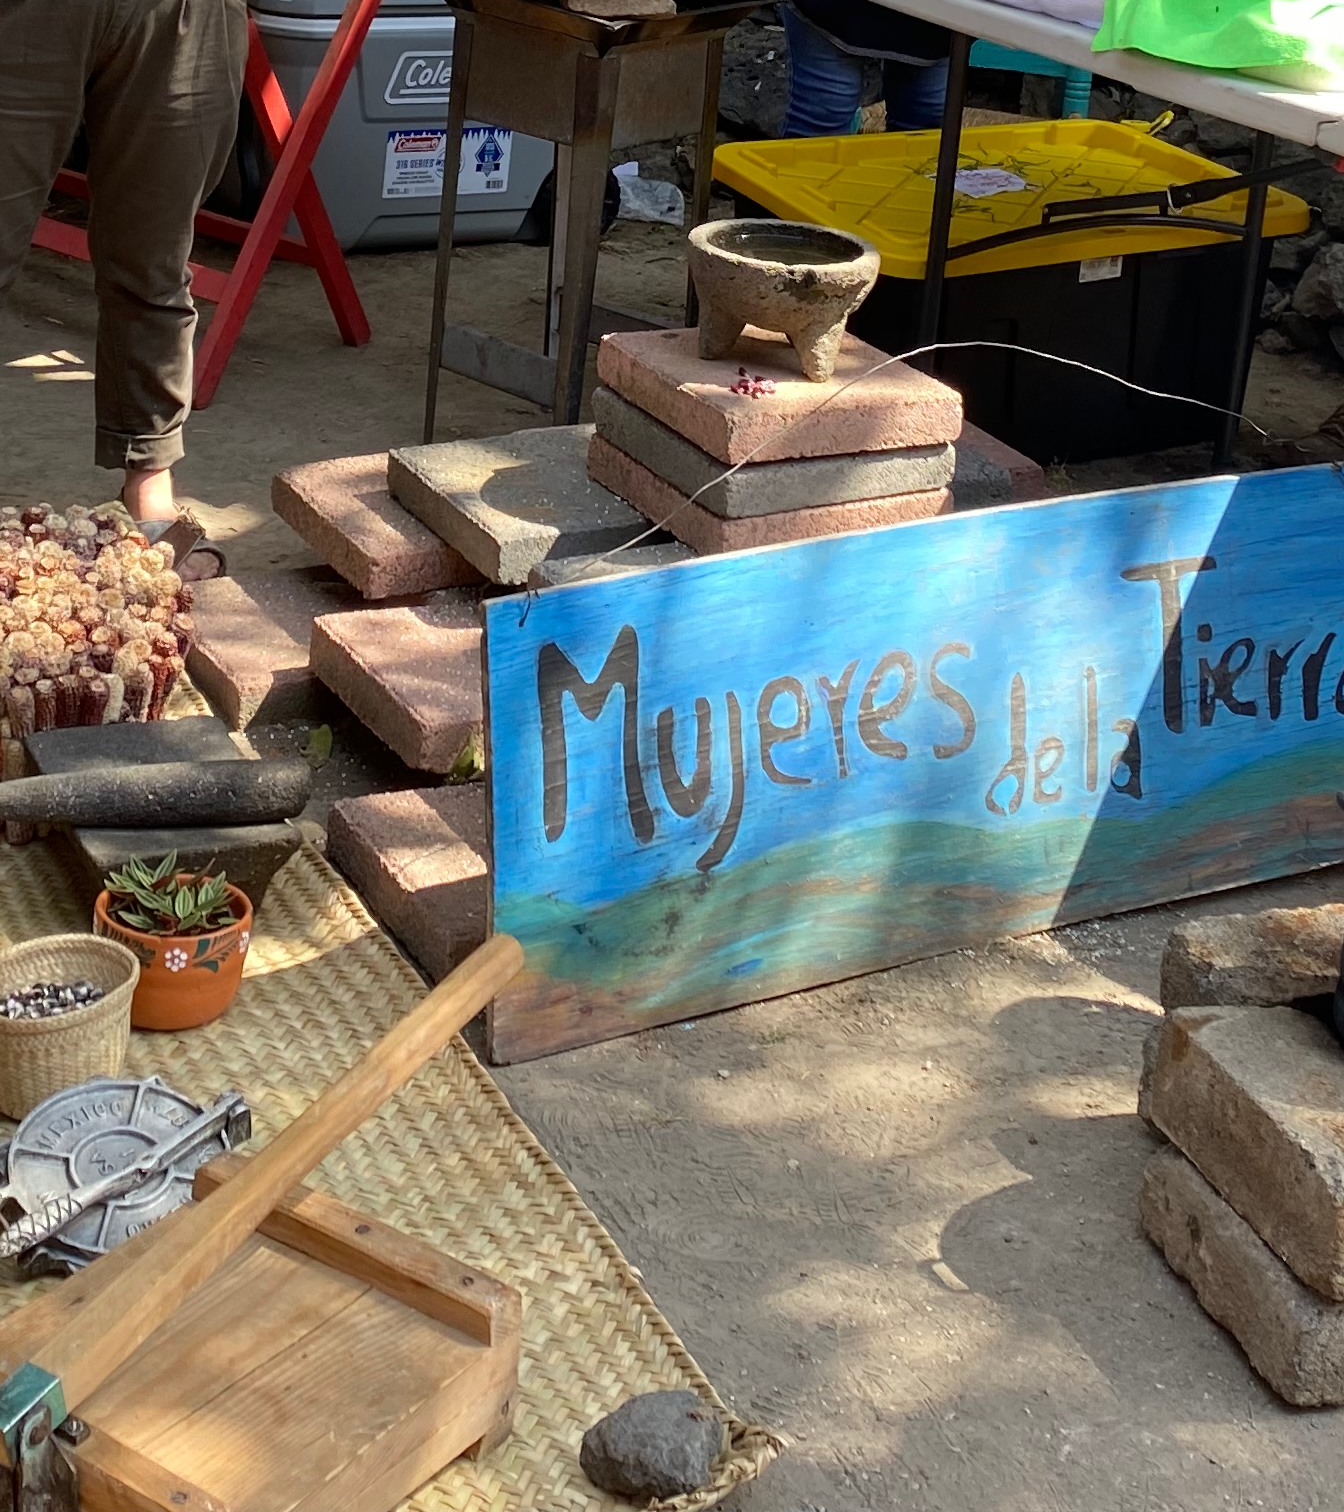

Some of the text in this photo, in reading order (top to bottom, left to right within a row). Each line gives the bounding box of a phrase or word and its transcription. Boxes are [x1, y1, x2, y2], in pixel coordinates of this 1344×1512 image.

[410, 158, 435, 169] SERIES
[536, 624, 977, 874] Mujeres
[984, 672, 1064, 817] de
[1084, 666, 1145, 801] la
